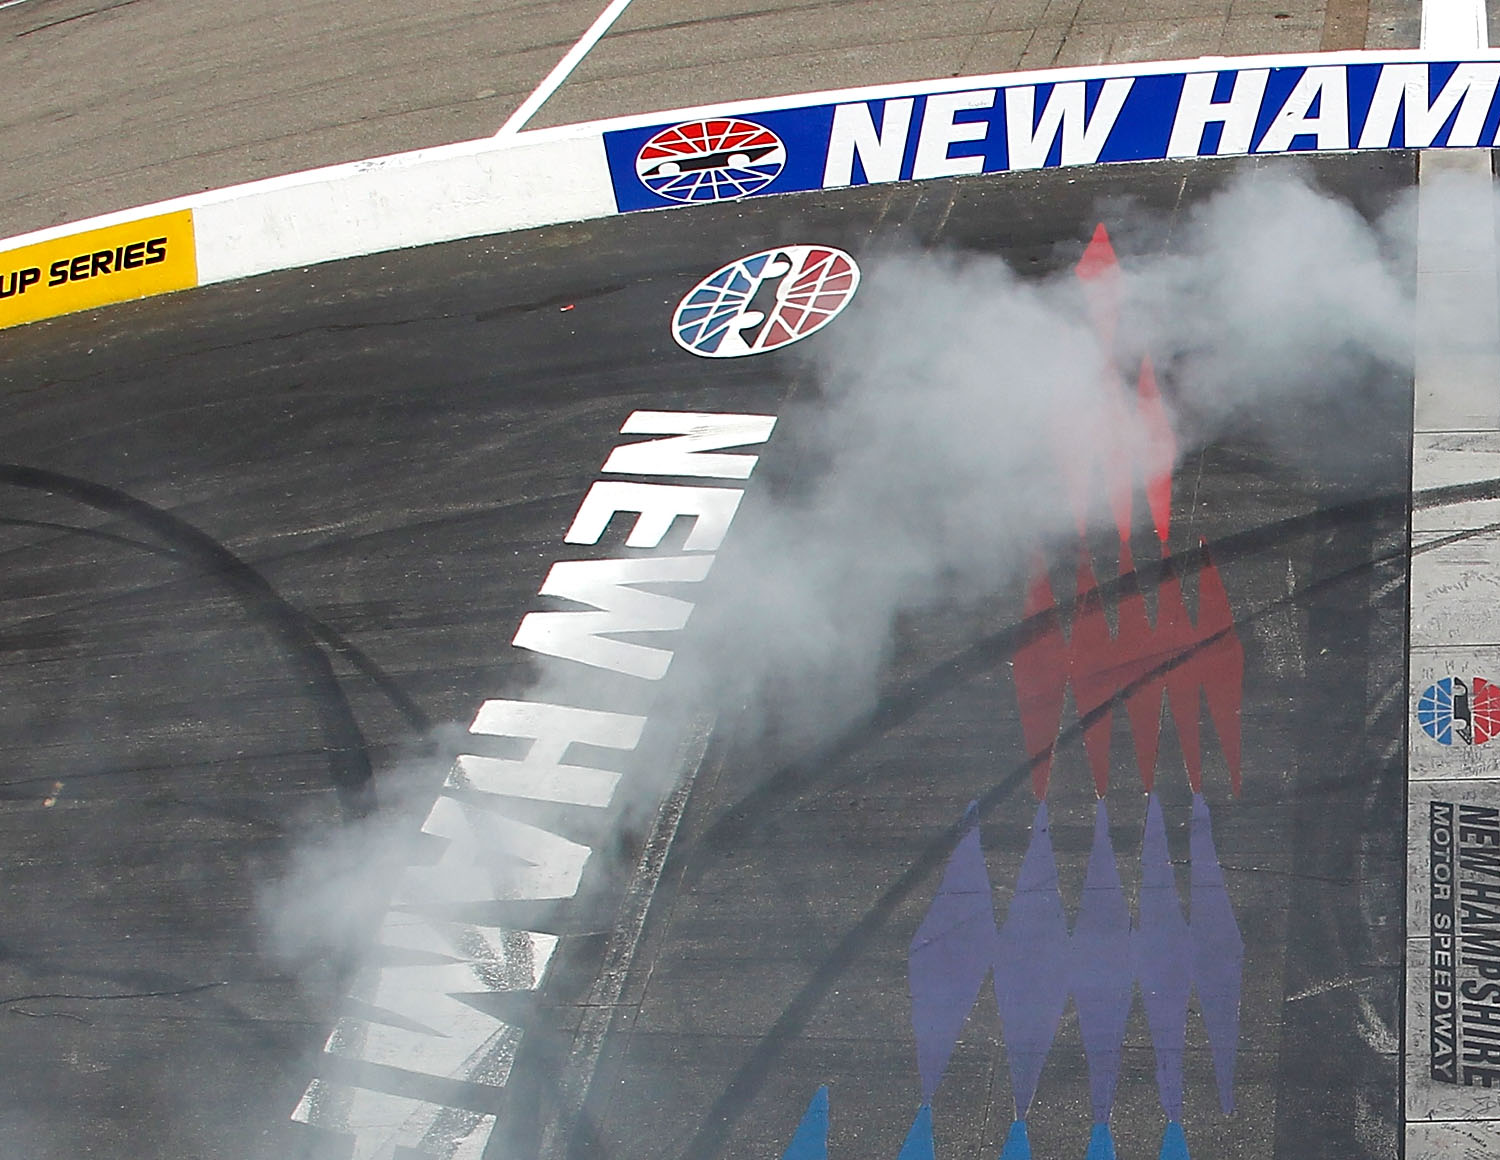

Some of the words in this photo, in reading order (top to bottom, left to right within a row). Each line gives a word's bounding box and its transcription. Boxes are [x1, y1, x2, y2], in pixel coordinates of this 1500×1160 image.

[823, 80, 1133, 188] NEW
[48, 237, 168, 287] SERIES
[512, 410, 777, 680] NEW
[1433, 805, 1451, 901] MOTOR
[1459, 804, 1500, 878] NEW
[1434, 912, 1454, 1081] SPEEDWAY
